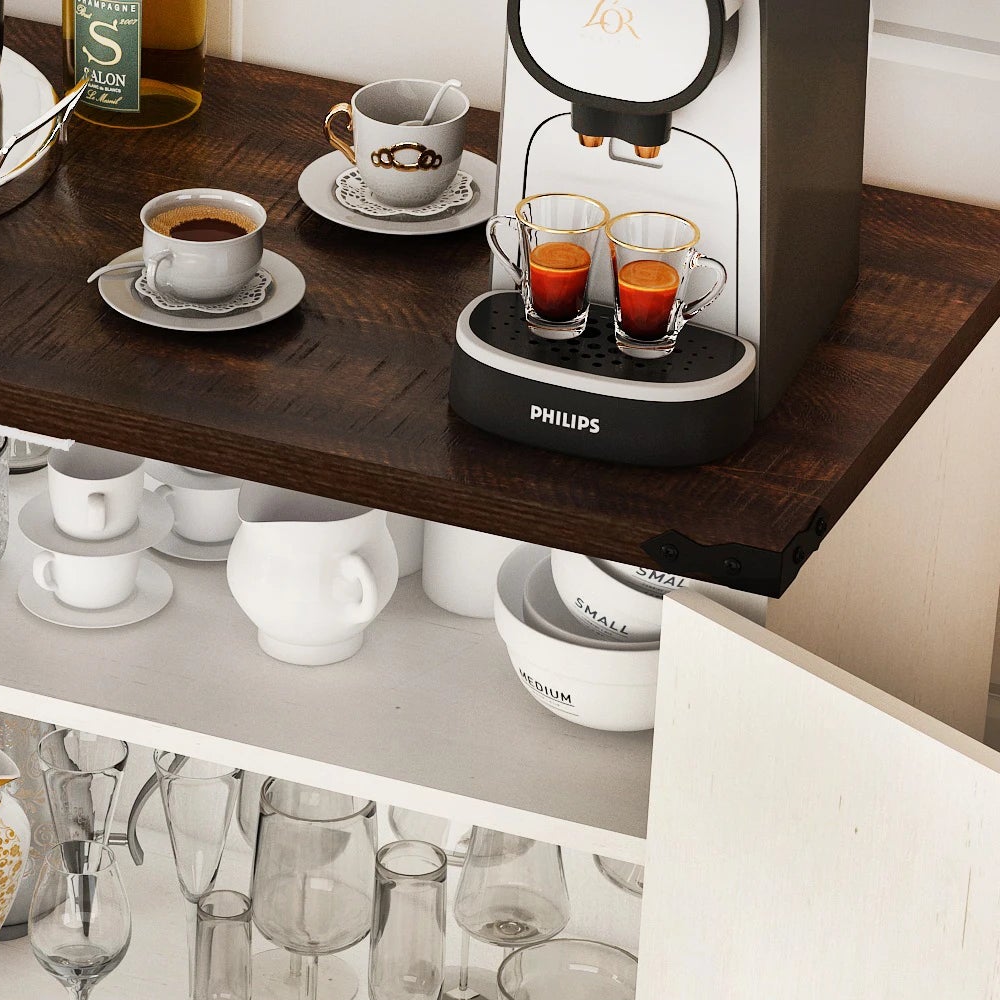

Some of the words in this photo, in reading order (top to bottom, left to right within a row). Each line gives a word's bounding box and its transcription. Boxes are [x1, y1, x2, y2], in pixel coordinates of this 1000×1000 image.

[77, 0, 136, 12] HAMPAGNE
[82, 19, 122, 66] S
[530, 404, 600, 434] PHILIPS
[635, 566, 686, 588] SMAL
[575, 597, 629, 635] SMALL
[519, 667, 572, 704] MEDIUM
